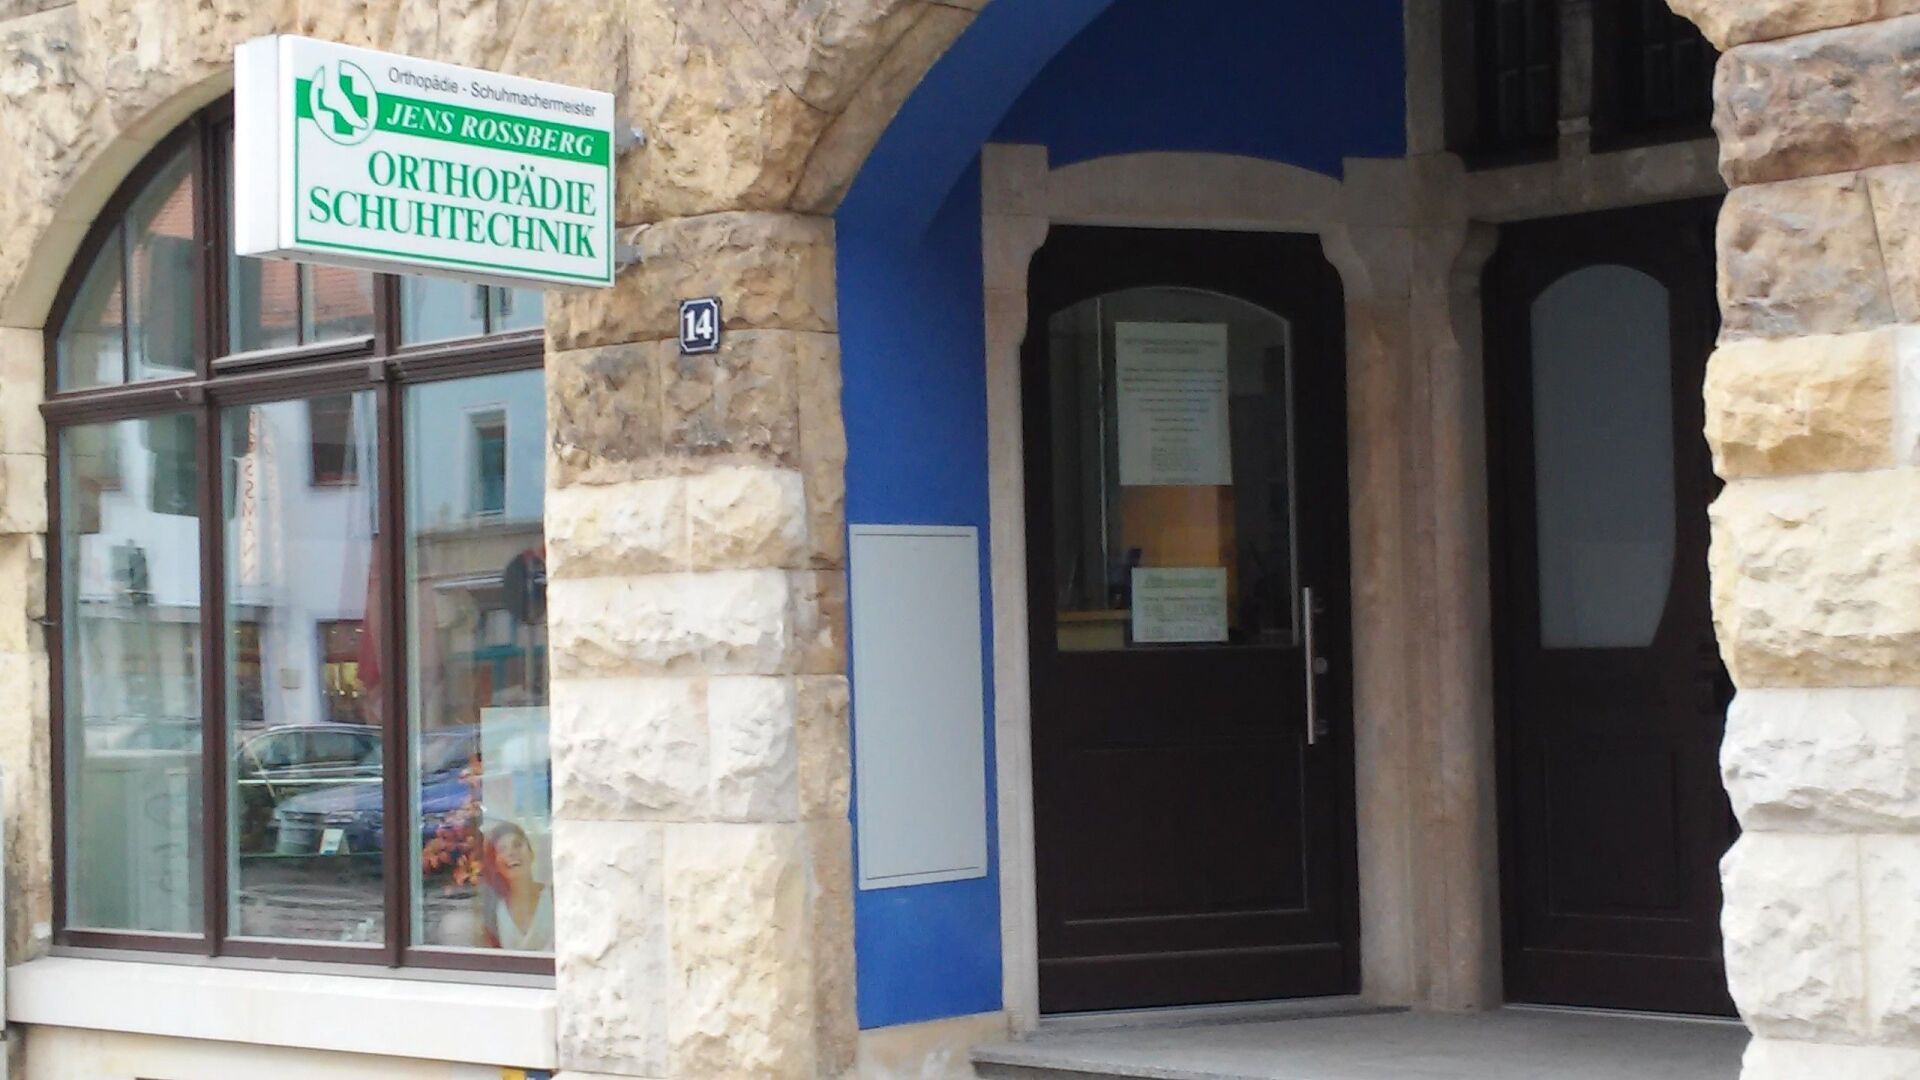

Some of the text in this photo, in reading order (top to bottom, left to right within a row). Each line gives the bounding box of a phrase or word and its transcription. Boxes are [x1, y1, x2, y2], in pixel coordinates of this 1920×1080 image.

[388, 66, 459, 93] Orthopädie
[471, 81, 597, 117] Schuhmachermeister
[386, 103, 595, 157] JENS ROSSBERG
[367, 150, 597, 216] ORTHOPÄDIE
[308, 185, 597, 259] SCHUHTECHNIK
[684, 308, 713, 341] 14
